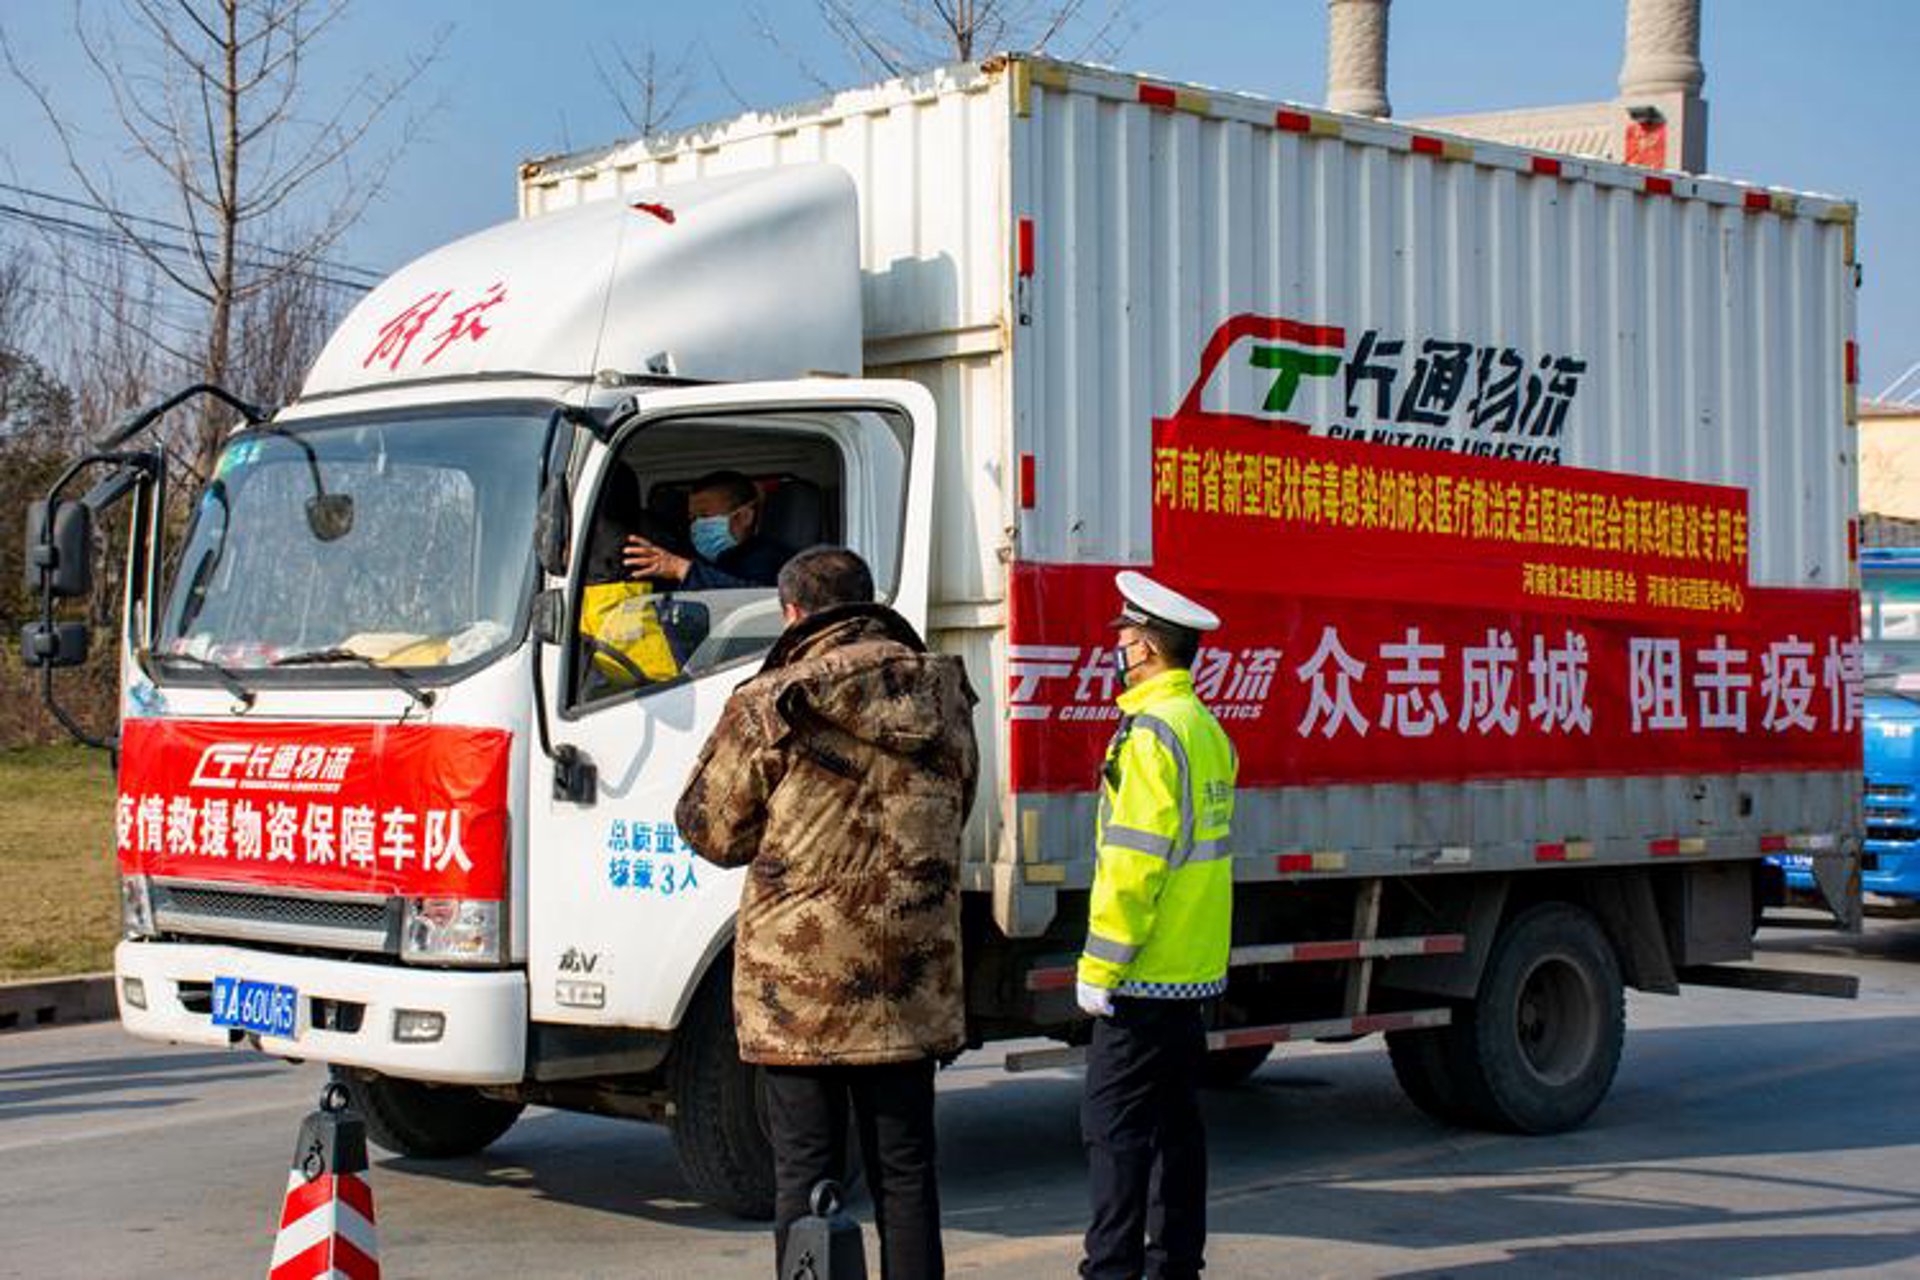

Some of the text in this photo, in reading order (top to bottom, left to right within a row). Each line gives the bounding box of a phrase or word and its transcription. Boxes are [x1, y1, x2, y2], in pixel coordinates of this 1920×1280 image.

[1296, 626, 1593, 739] 众志成城
[1628, 633, 1863, 737] 阻击疫情
